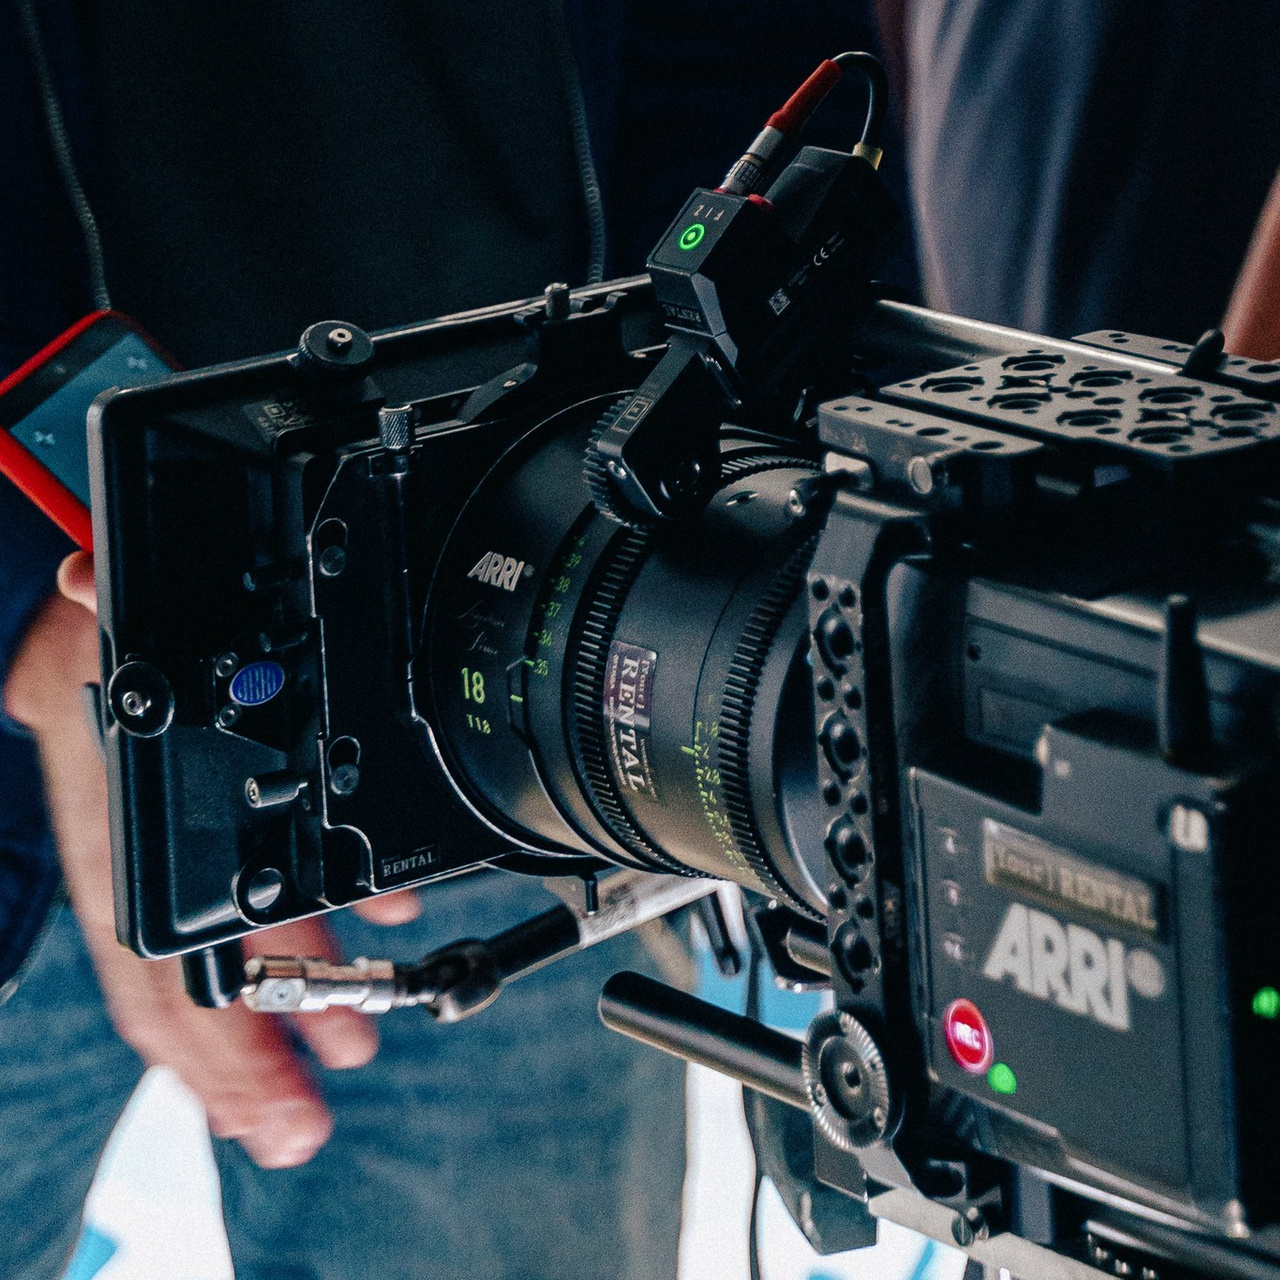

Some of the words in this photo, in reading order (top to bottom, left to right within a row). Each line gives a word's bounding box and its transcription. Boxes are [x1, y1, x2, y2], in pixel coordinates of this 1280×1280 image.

[467, 551, 525, 592] ARRI
[461, 667, 486, 704] 18
[615, 656, 646, 792] RENTAL
[383, 851, 436, 877] RENTAL
[983, 902, 1131, 1032] ARRI
